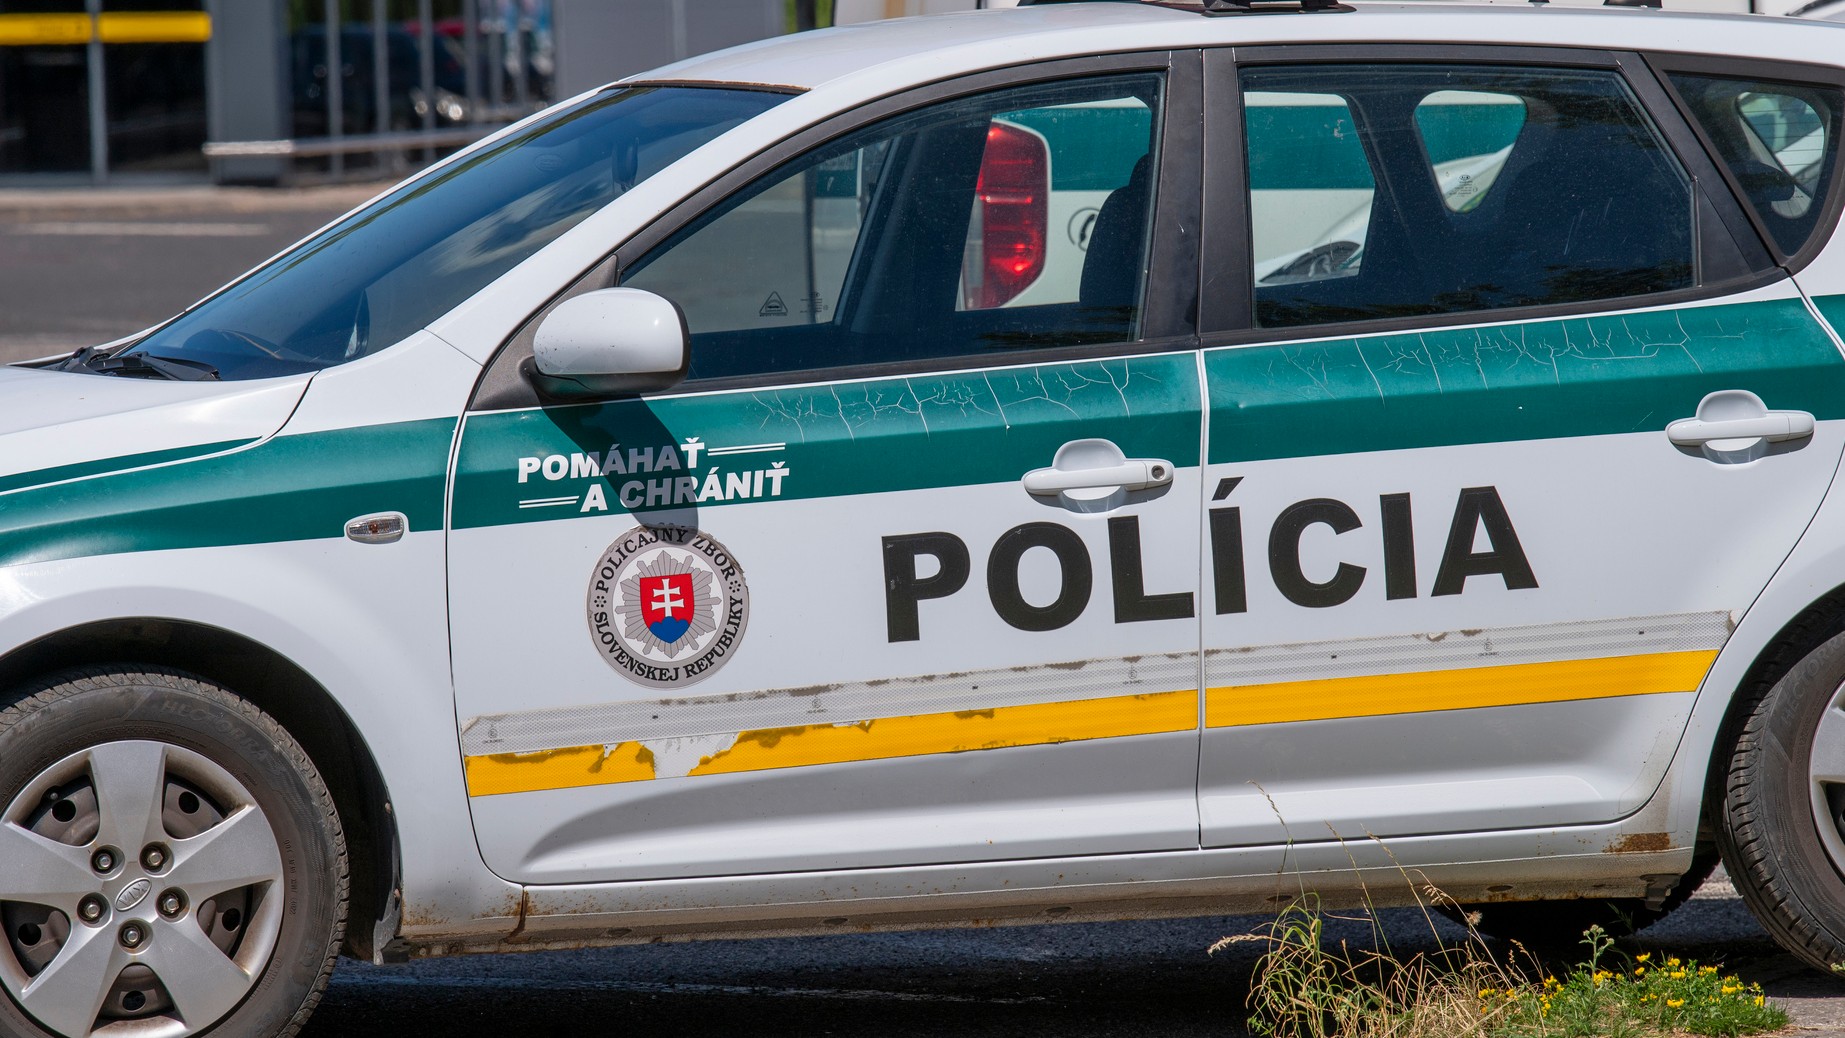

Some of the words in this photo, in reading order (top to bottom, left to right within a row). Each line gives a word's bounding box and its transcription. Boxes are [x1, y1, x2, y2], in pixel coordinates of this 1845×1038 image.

[518, 437, 705, 483] POMÁHAŤ
[580, 484, 608, 512] A
[620, 462, 790, 508] CHRÁNIŤ
[595, 525, 689, 594] POLICAJNÝ
[692, 534, 737, 581] ZBOR
[881, 476, 1540, 643] POLÍCIA
[594, 611, 680, 682] SLOVENSKEJ
[684, 596, 743, 679] REPUBLIKY
